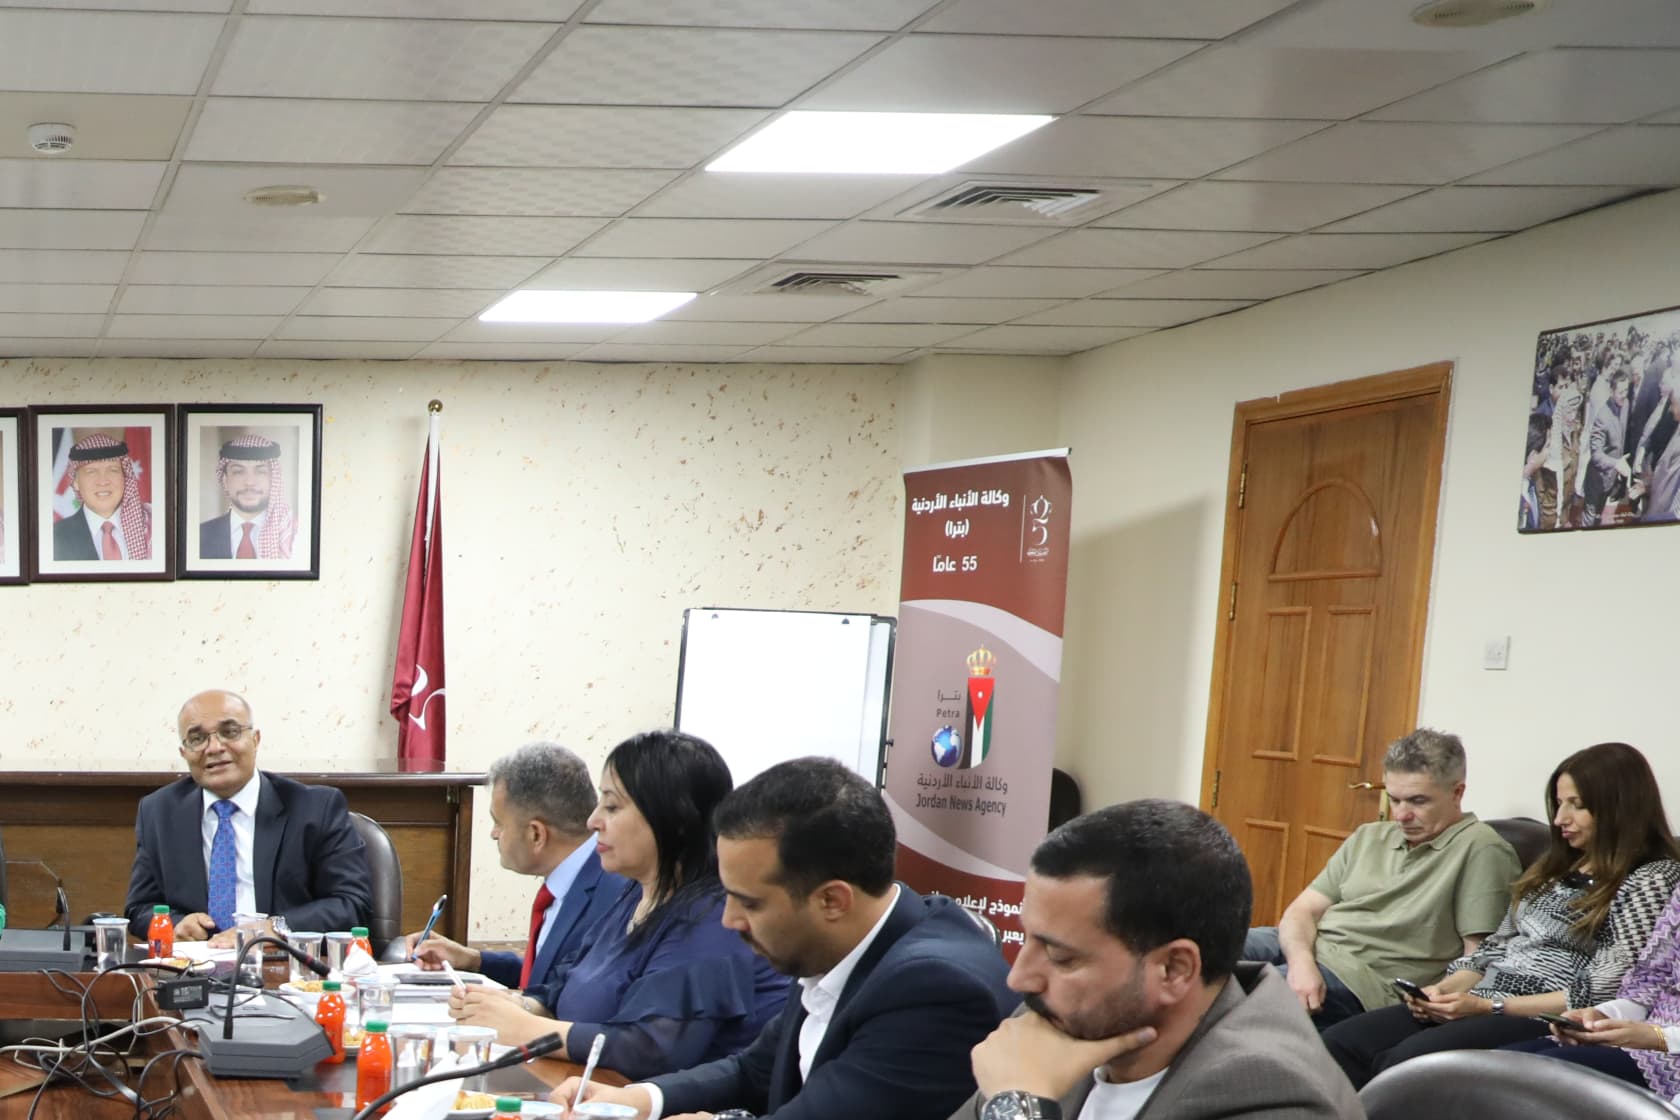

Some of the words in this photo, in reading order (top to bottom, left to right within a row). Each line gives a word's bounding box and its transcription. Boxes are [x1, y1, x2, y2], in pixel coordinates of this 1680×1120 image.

[911, 493, 948, 515] الأردنية
[949, 490, 979, 511] الأنباء
[981, 489, 1010, 508] وكالة
[945, 518, 970, 539] (بترا)
[961, 555, 978, 571] 55
[936, 708, 960, 718] Petra
[917, 772, 953, 790] الأردنية
[956, 773, 983, 792] الأنباء
[985, 775, 1008, 796] وكالة
[915, 793, 947, 809] Jordan
[950, 795, 974, 812] News
[974, 796, 1007, 817] Agency
